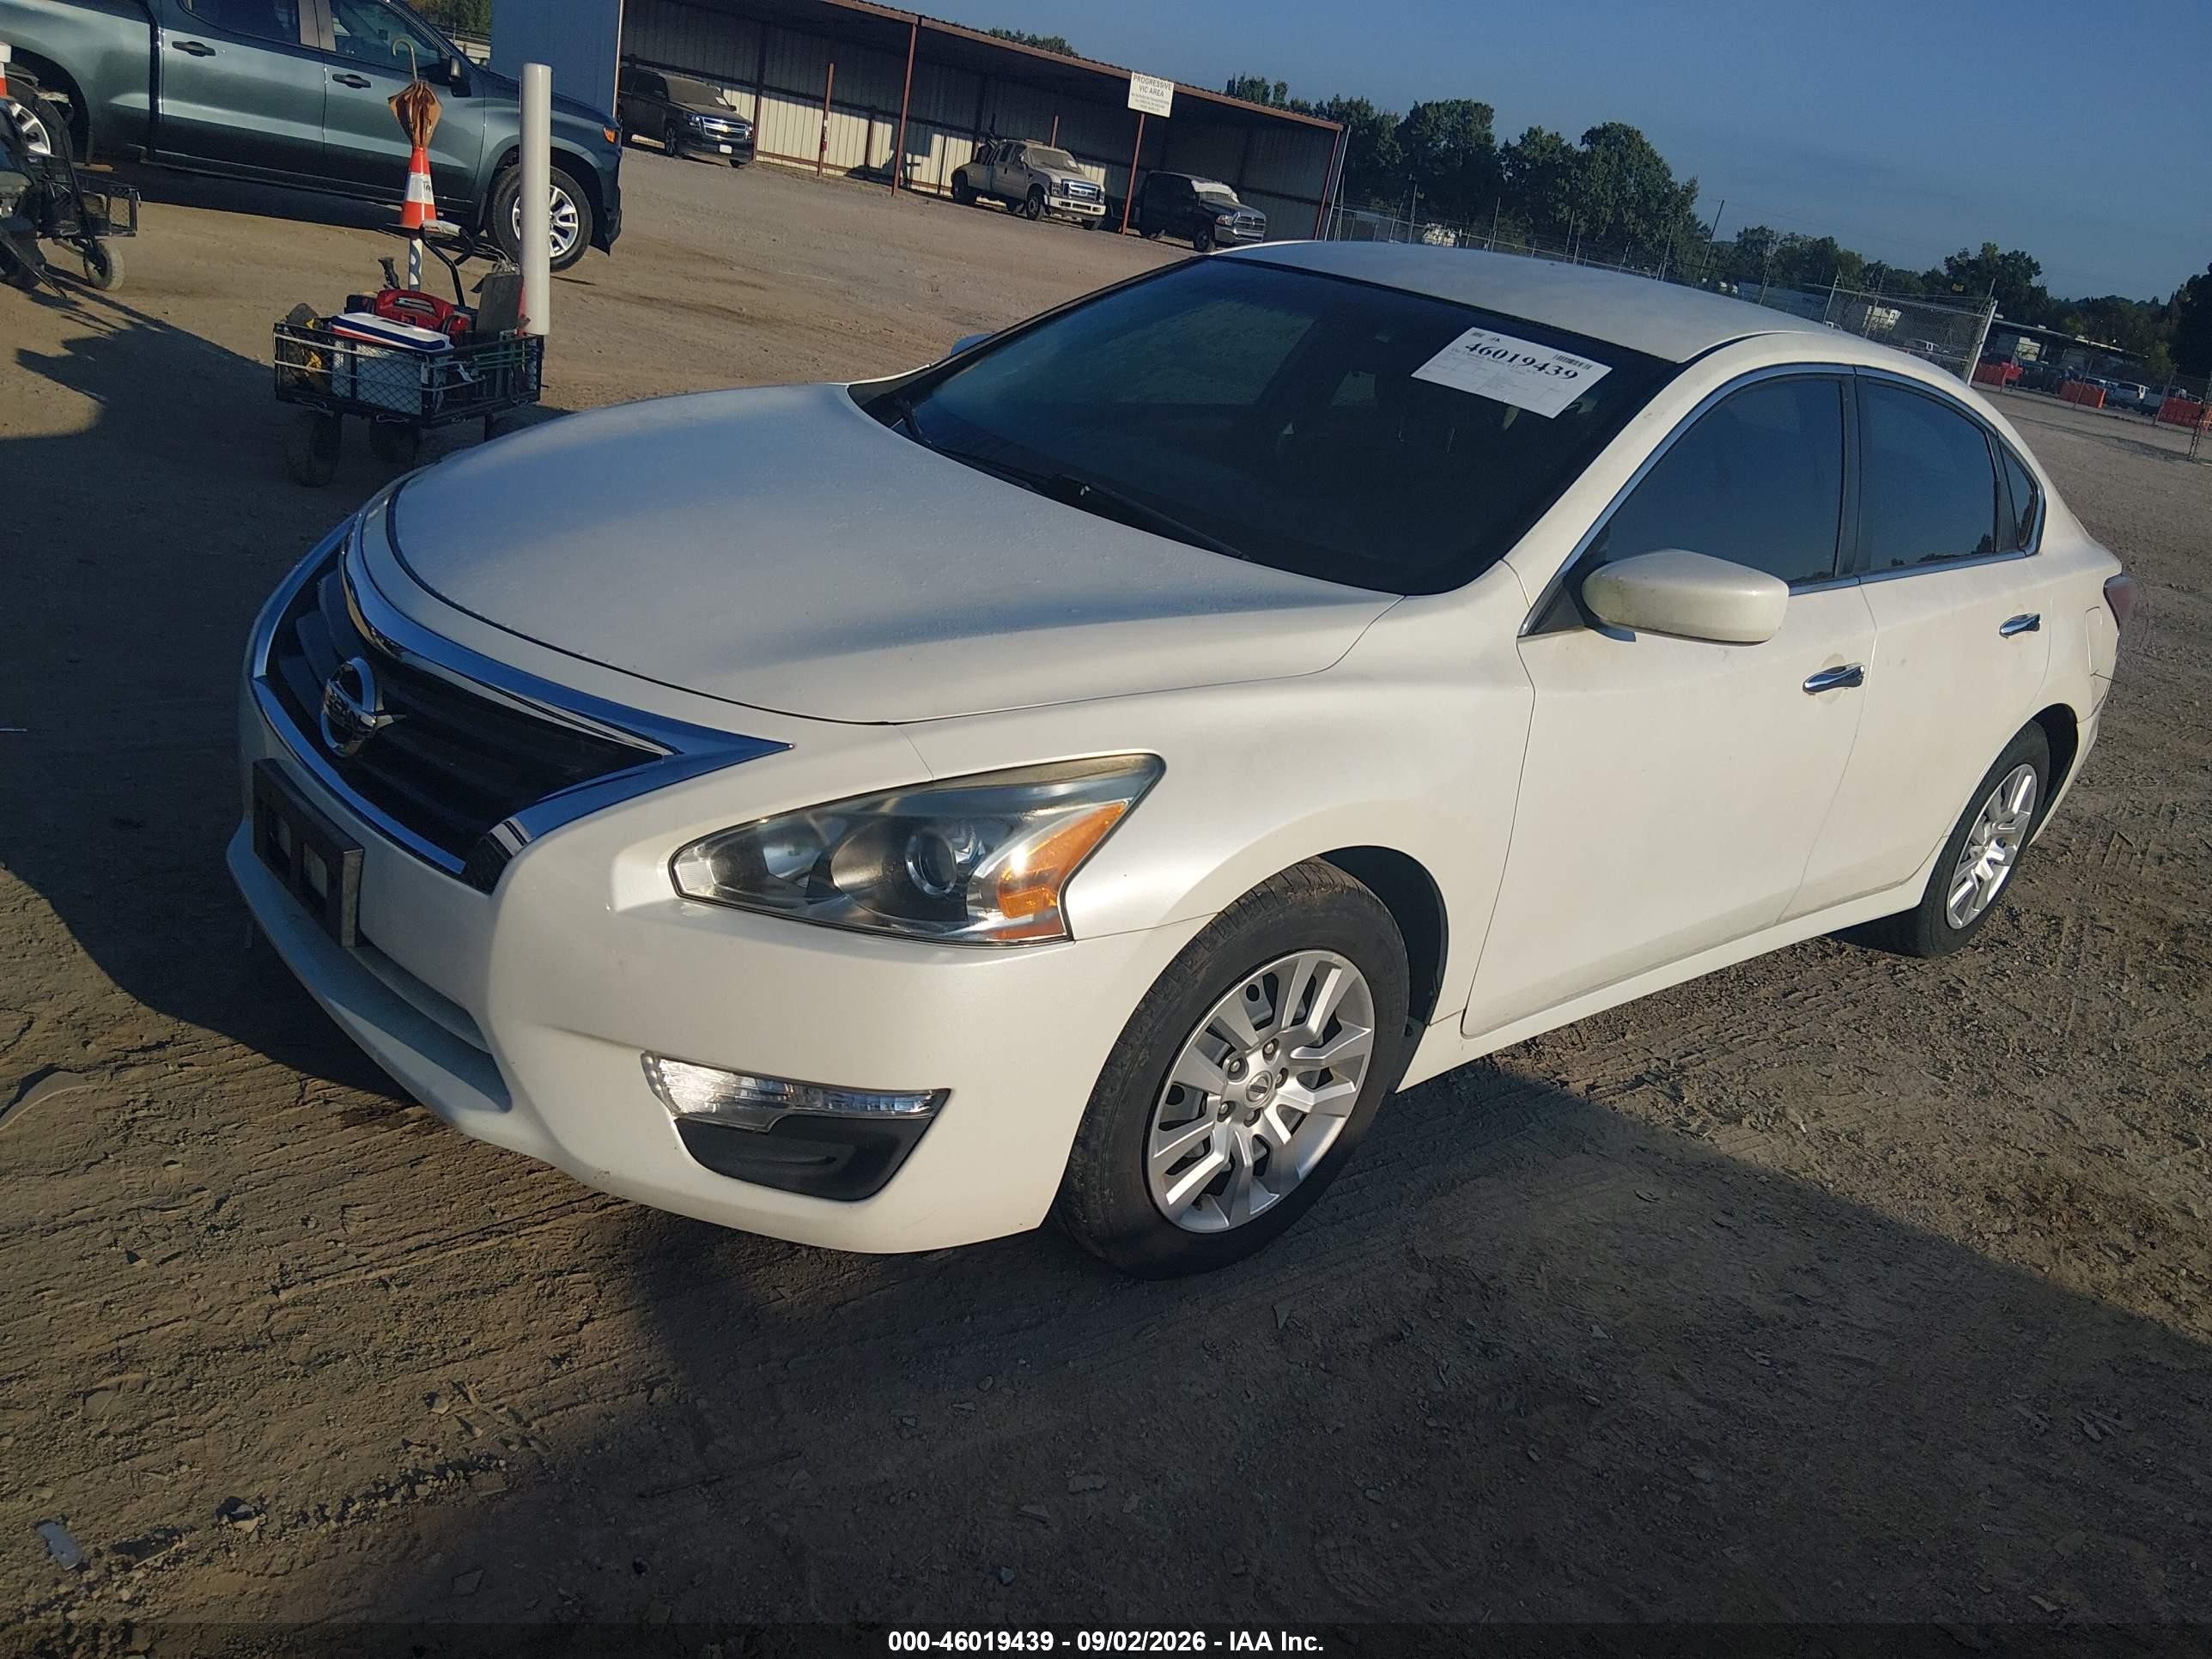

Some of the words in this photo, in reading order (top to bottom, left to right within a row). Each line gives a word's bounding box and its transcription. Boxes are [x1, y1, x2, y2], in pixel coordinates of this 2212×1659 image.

[1133, 75, 1172, 90] PROGRESSIVE
[1149, 88, 1164, 96] AREA
[1465, 343, 1578, 379] 46019439
